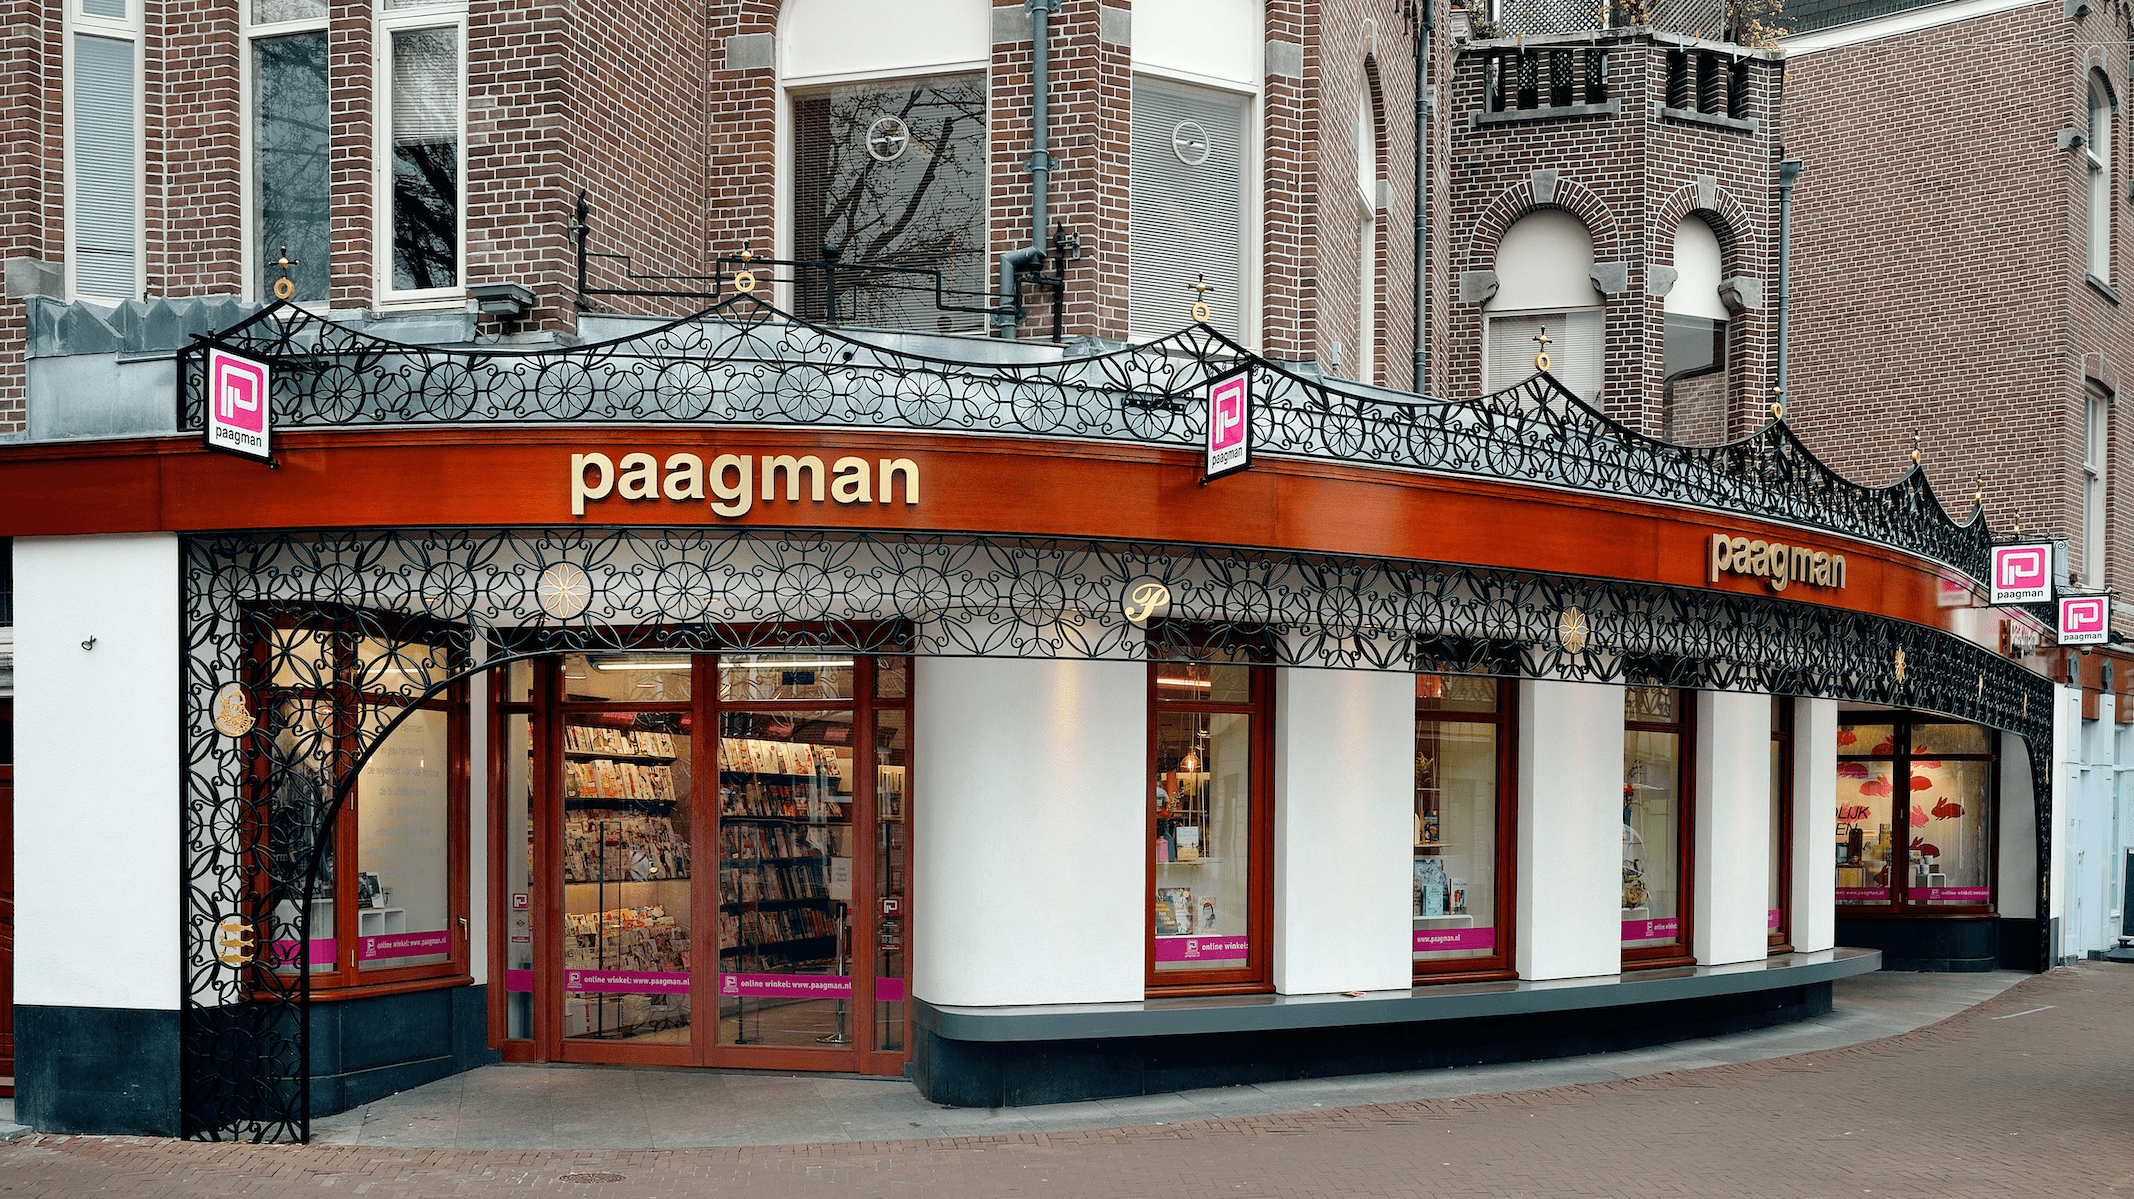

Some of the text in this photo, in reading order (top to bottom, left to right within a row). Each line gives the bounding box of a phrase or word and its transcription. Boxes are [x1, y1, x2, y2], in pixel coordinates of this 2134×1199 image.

[216, 426, 252, 448] paagman
[1211, 446, 1243, 469] paagman
[571, 452, 920, 518] paagman
[1711, 532, 1847, 592] paagman
[1997, 589, 2044, 600] paagman
[2063, 632, 2103, 642] paagman
[1417, 934, 1461, 944] www.paagman.nl
[1201, 941, 1249, 951] online winkel:
[584, 975, 690, 987] online winkel: www.paagman.nl
[740, 980, 853, 990] online winkel: www.paagman.nl
